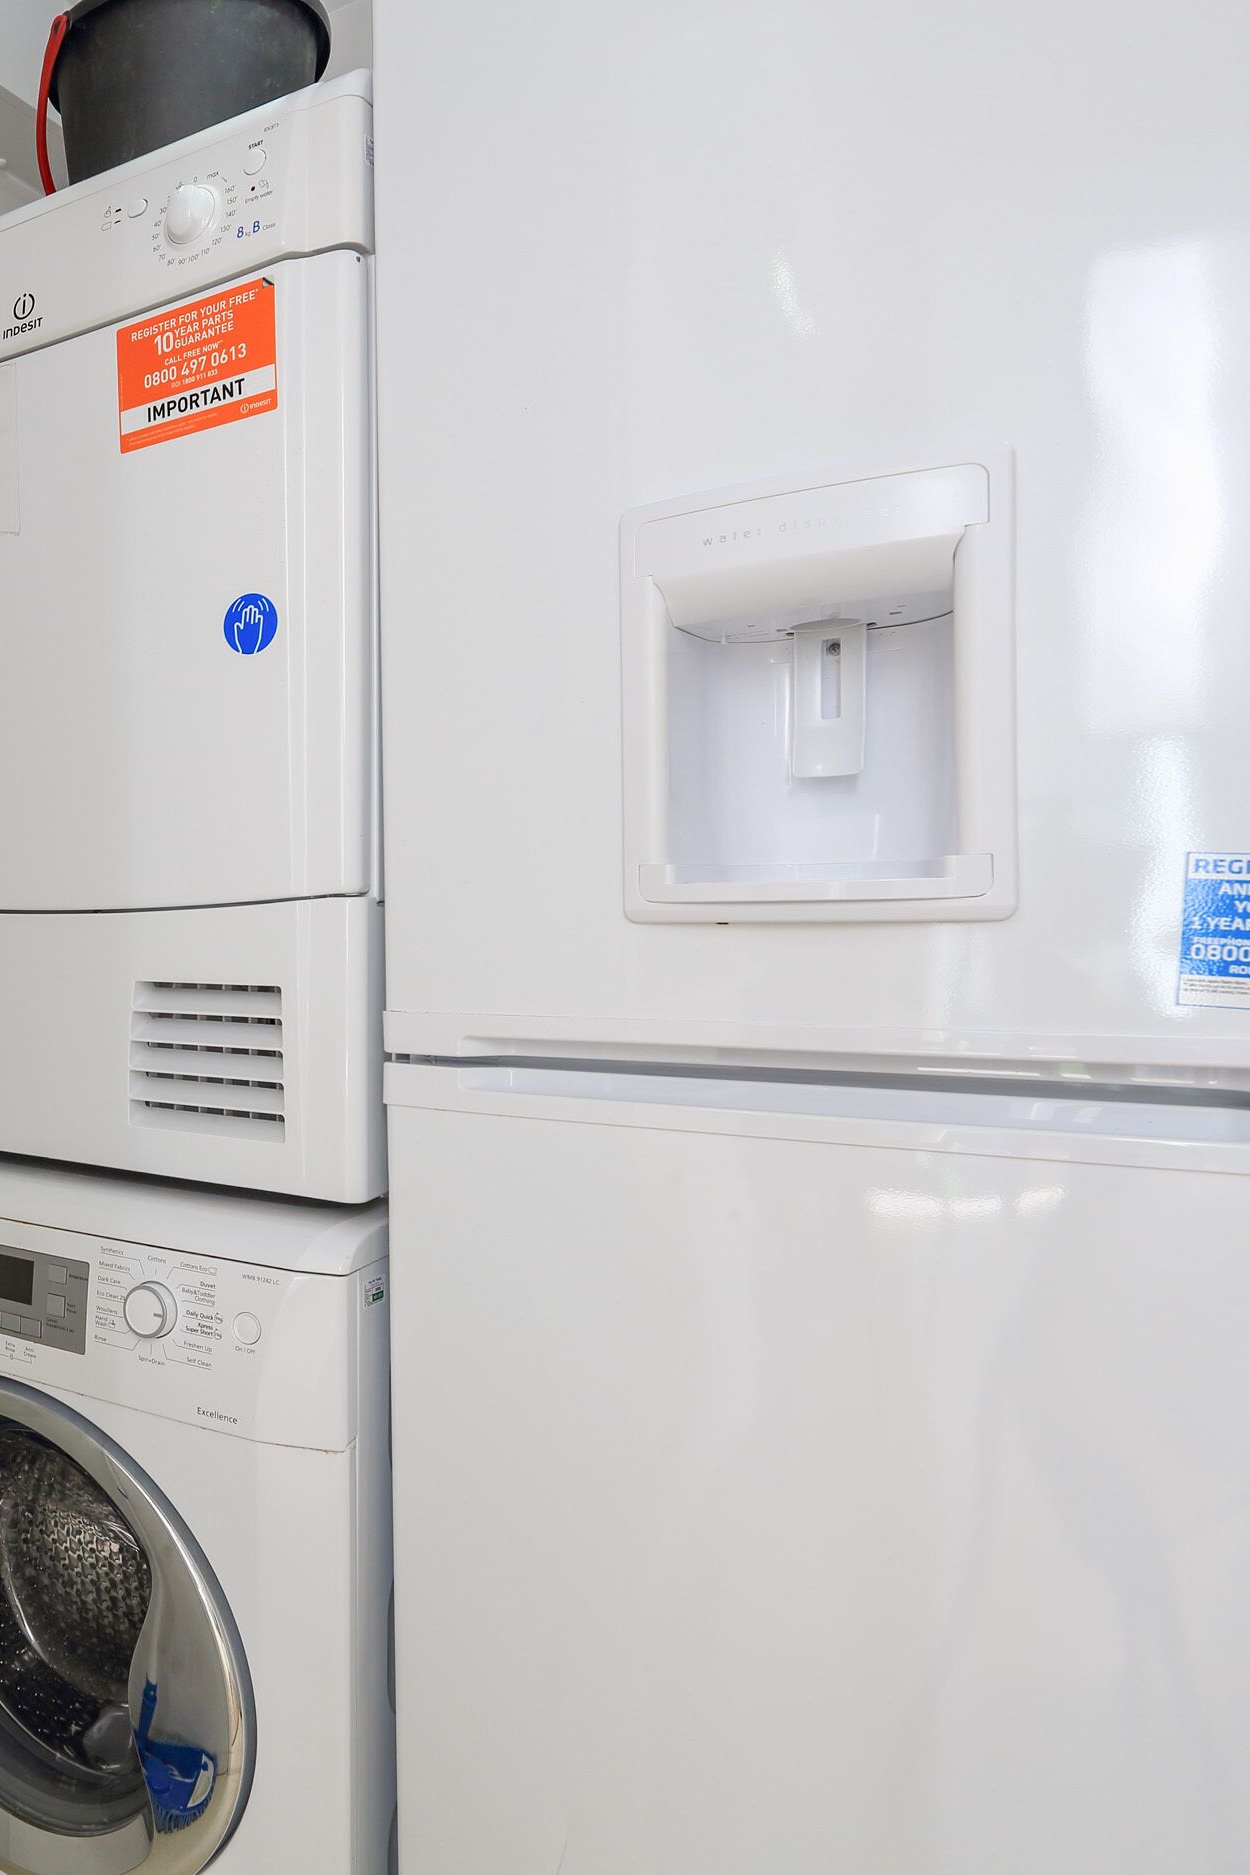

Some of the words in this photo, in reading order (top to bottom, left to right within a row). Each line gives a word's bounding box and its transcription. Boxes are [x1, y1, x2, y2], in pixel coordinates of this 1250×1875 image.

[248, 139, 264, 150] START
[206, 170, 220, 180] max
[237, 226, 244, 239] 8
[252, 220, 261, 234] B
[262, 222, 276, 231] Class
[131, 319, 177, 343] REGISTER
[178, 310, 198, 327] FOR
[200, 300, 227, 321] YOUR
[174, 321, 200, 339] YEAR
[202, 310, 234, 328] PARTS
[174, 321, 235, 349] GUARANTEE
[154, 330, 174, 356] 10
[164, 355, 183, 366] CALL
[183, 345, 202, 360] FREE
[144, 365, 177, 389] 0800
[181, 356, 207, 376] 497
[211, 343, 247, 367] 0613
[171, 380, 182, 389] ROI
[196, 372, 207, 382] 911
[147, 378, 245, 423] IMPORTANT
[703, 528, 762, 547] water
[1190, 916, 1202, 929] 1
[1190, 945, 1250, 962] 0800
[100, 1246, 125, 1256] Synthetics
[147, 1255, 167, 1264] Cottons
[98, 1260, 114, 1269] Mixed
[114, 1263, 131, 1272] Fabrics
[180, 1262, 199, 1271] Cottons
[97, 1275, 109, 1283] Dark
[109, 1277, 121, 1285] Care
[200, 1281, 216, 1289] Duvet
[242, 1273, 256, 1281] WMB
[272, 1278, 280, 1286] LC
[105, 1292, 119, 1300] Clean
[181, 1287, 216, 1299] Baby&Toddler
[194, 1295, 216, 1306] Clothing
[96, 1305, 118, 1315] Woollens
[186, 1310, 199, 1319] Daily
[199, 1312, 214, 1321] Quick
[95, 1320, 108, 1328] Wash
[197, 1322, 214, 1332] Xpress
[185, 1325, 200, 1335] Super
[200, 1329, 214, 1337] Short
[94, 1334, 107, 1342] Rinse
[183, 1341, 204, 1350] Freshen
[204, 1345, 213, 1353] Up
[186, 1356, 197, 1364] Self
[197, 1359, 212, 1368] Clean
[197, 1406, 238, 1425] Excellence
